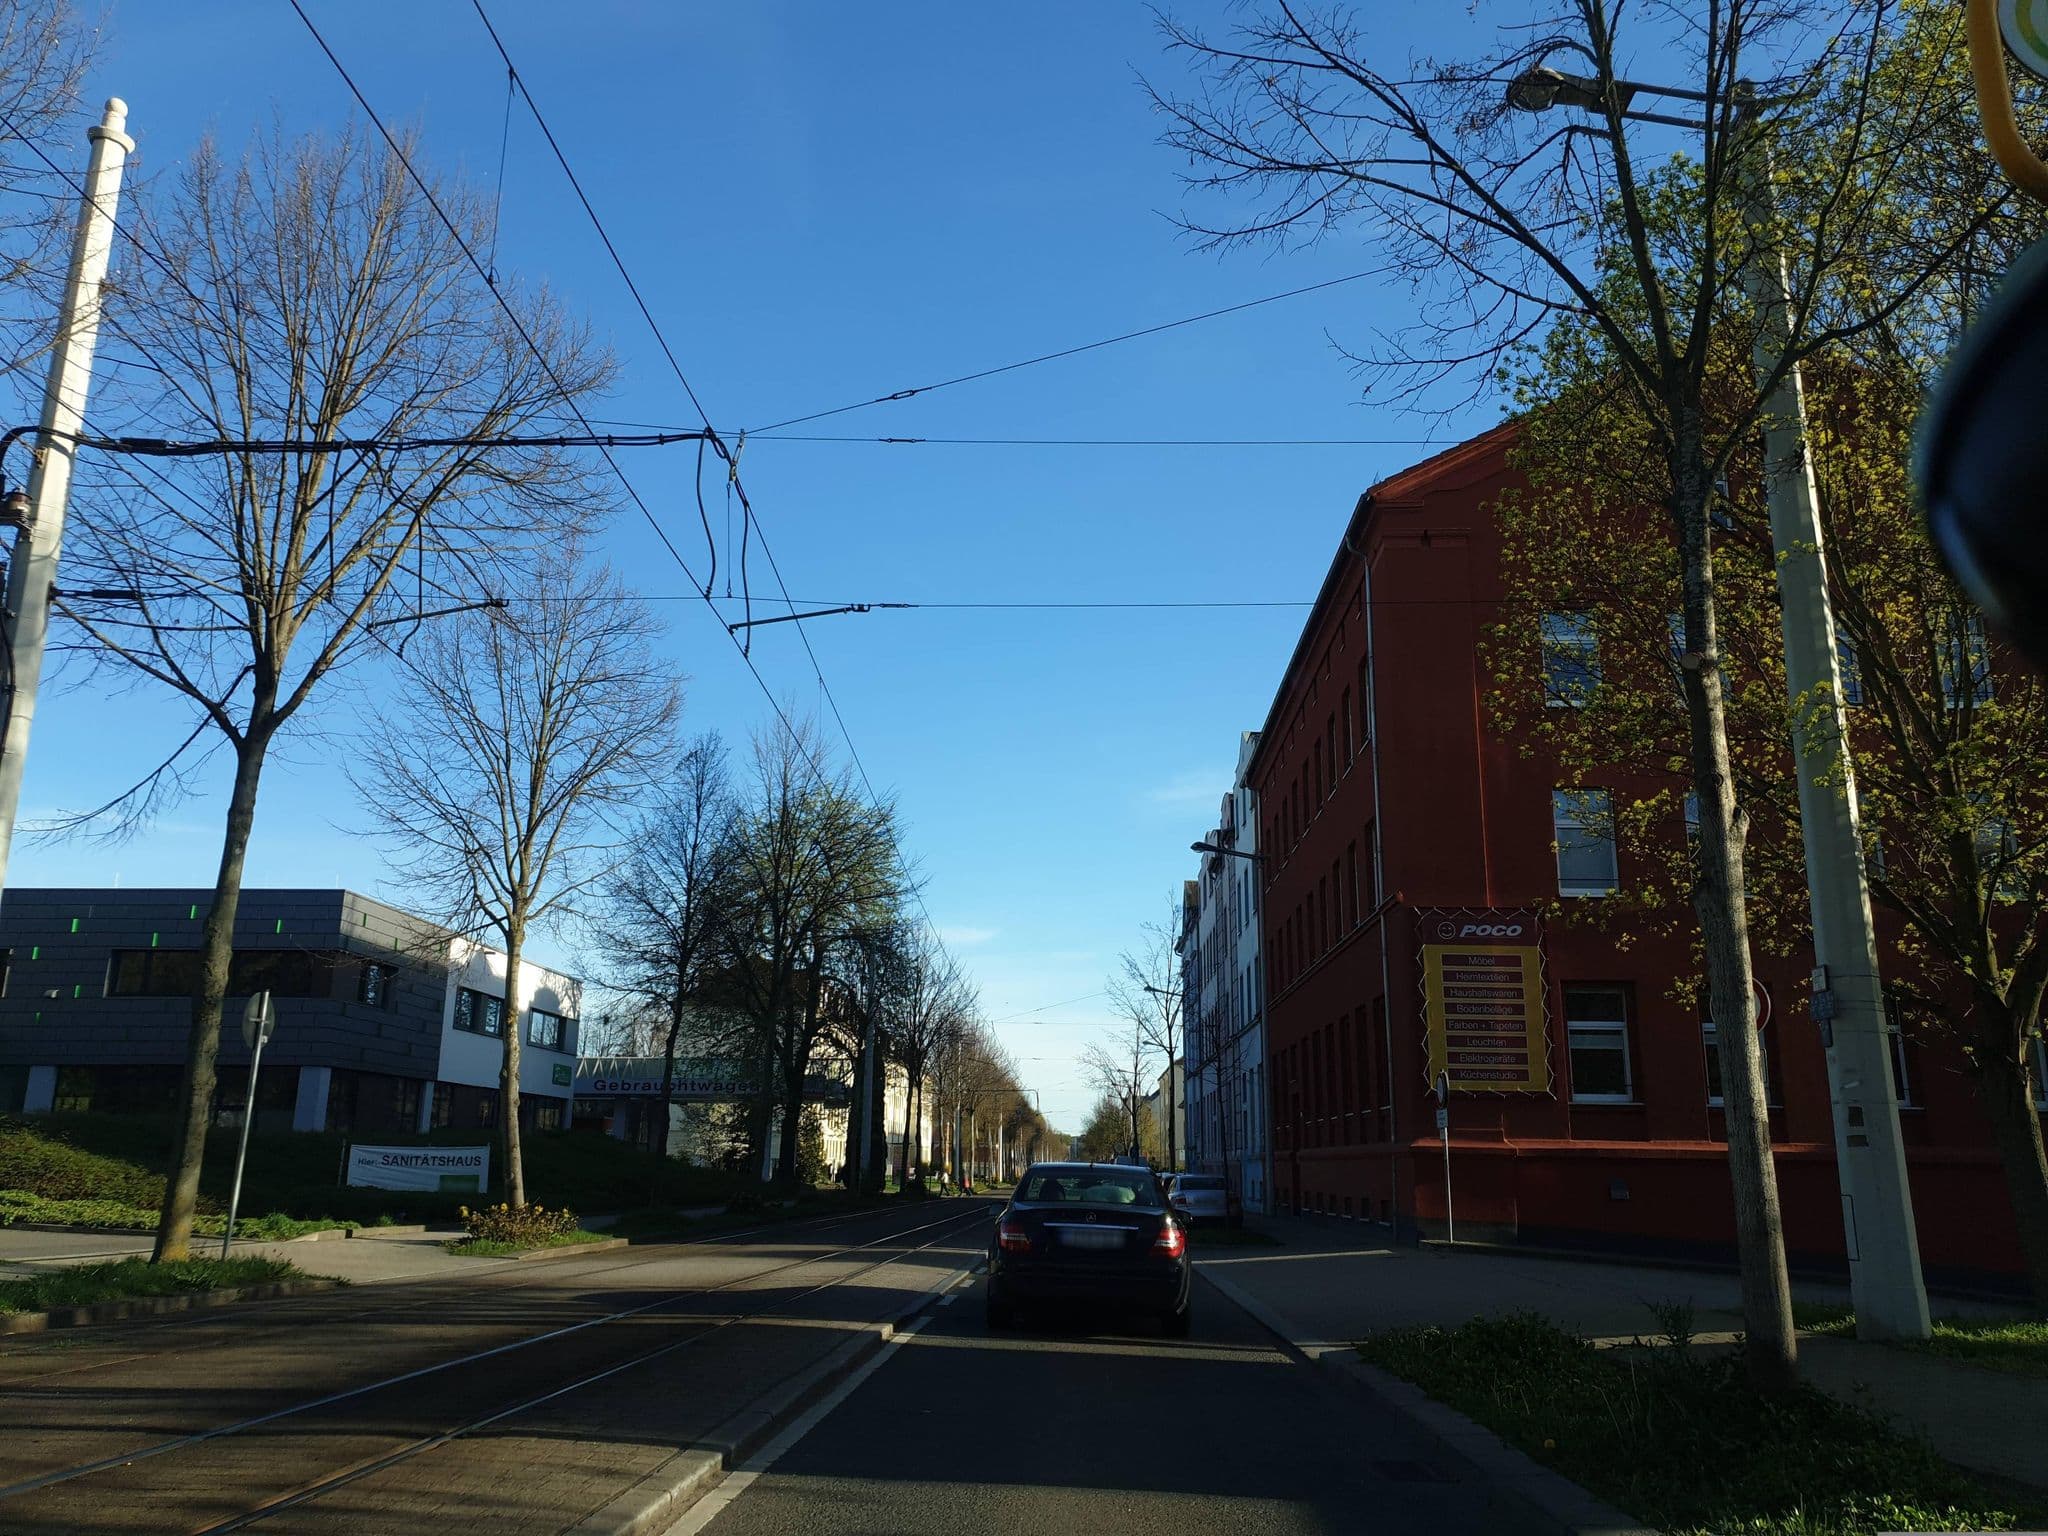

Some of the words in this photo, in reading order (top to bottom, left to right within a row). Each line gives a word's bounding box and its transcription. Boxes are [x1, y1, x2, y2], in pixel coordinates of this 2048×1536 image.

[1459, 924, 1523, 938] POCO
[1468, 956, 1496, 966] Möbel
[1455, 971, 1510, 982] Heimtextilien
[1449, 988, 1518, 998] Haushaltswaren
[1456, 1004, 1513, 1015] Bodenbeläge
[1448, 1021, 1480, 1030] Farben
[1489, 1021, 1524, 1032] Tapeten
[1466, 1037, 1507, 1047] Leuchten
[1459, 1053, 1516, 1064] Elektrogeräte
[1459, 1069, 1518, 1080] Küchenstudio
[380, 1153, 482, 1167] SANITÄTSHAUS
